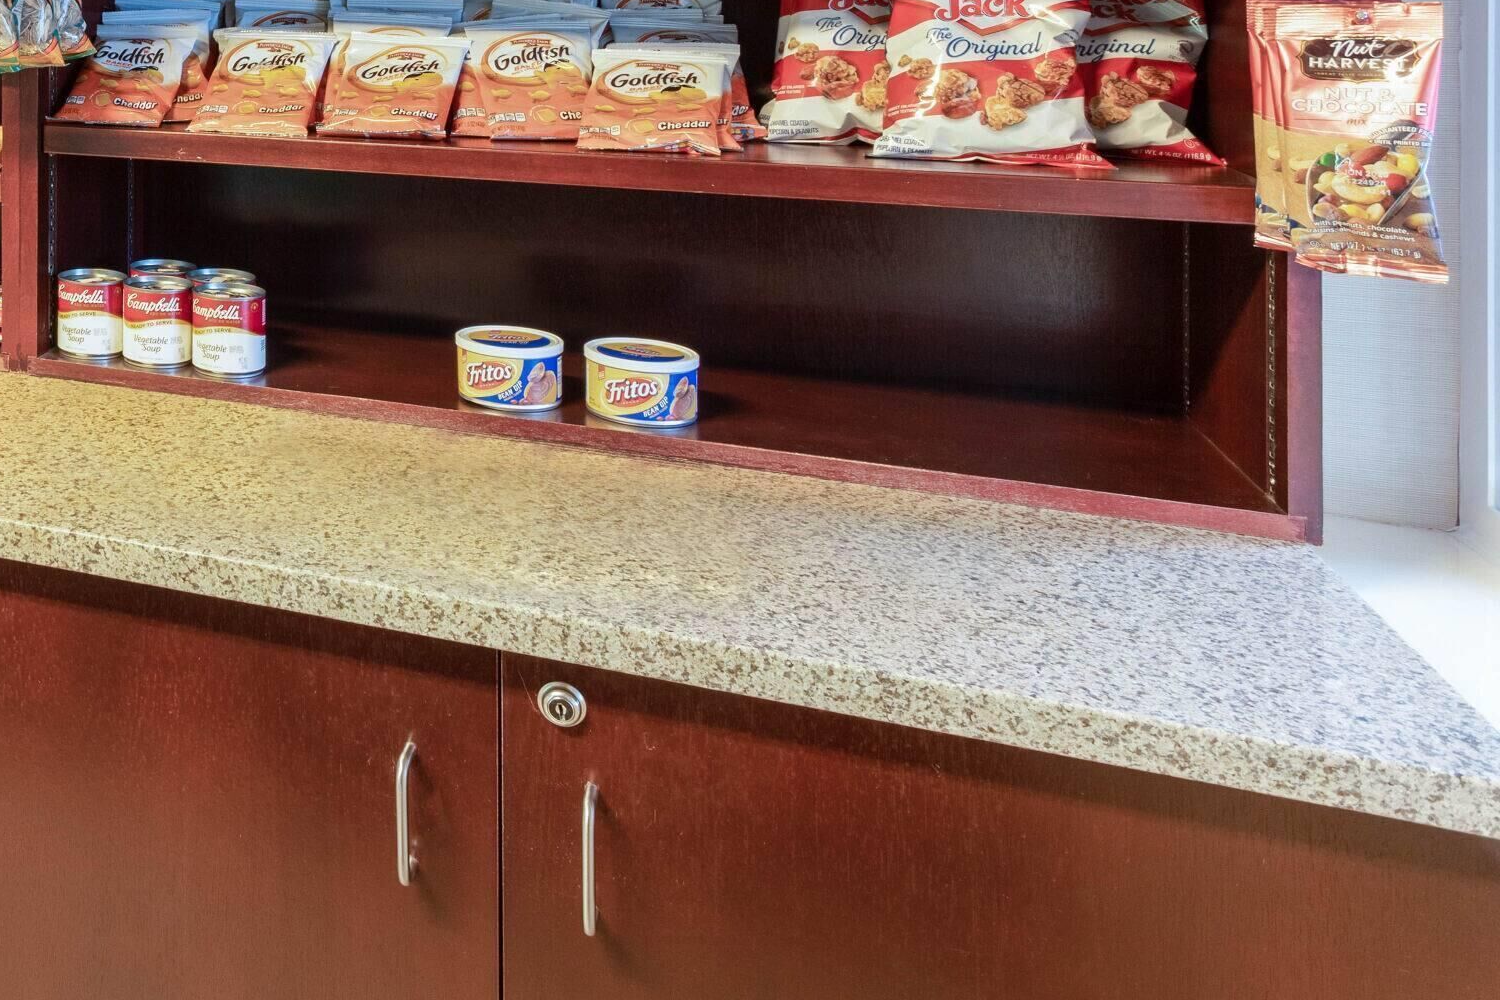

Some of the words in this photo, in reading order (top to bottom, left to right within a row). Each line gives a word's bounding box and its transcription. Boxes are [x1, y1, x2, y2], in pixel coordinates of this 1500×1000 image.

[816, 16, 843, 33] The
[945, 31, 1043, 62] Original
[1331, 39, 1386, 59] Nut
[94, 45, 165, 66] Goldfish
[232, 52, 305, 72] Goldfish
[494, 45, 571, 71] Goldfish
[361, 59, 440, 80] Goldfish
[610, 72, 701, 88] Goldfish
[1323, 86, 1372, 102] NUT
[113, 97, 158, 110] Cheddar
[258, 104, 305, 114] Cheddar
[1291, 98, 1429, 118] CHOCOLATE
[390, 107, 438, 121] Cheddar
[657, 120, 712, 131] Cheddar
[1380, 233, 1416, 243] cashews
[127, 293, 181, 314] Campbell's
[193, 298, 241, 320] Campbell's
[62, 324, 92, 336] Vegetable
[67, 336, 85, 344] Soup
[133, 333, 168, 346] Vegetable
[197, 340, 227, 353] Vegetable
[141, 343, 162, 355] Soup
[203, 352, 220, 362] Soup
[466, 361, 513, 386] Fritos
[497, 386, 514, 400] BEAN
[512, 379, 524, 392] DIP
[604, 377, 659, 405] Fritos
[642, 403, 659, 418] BEAN
[658, 395, 670, 409] DIP
